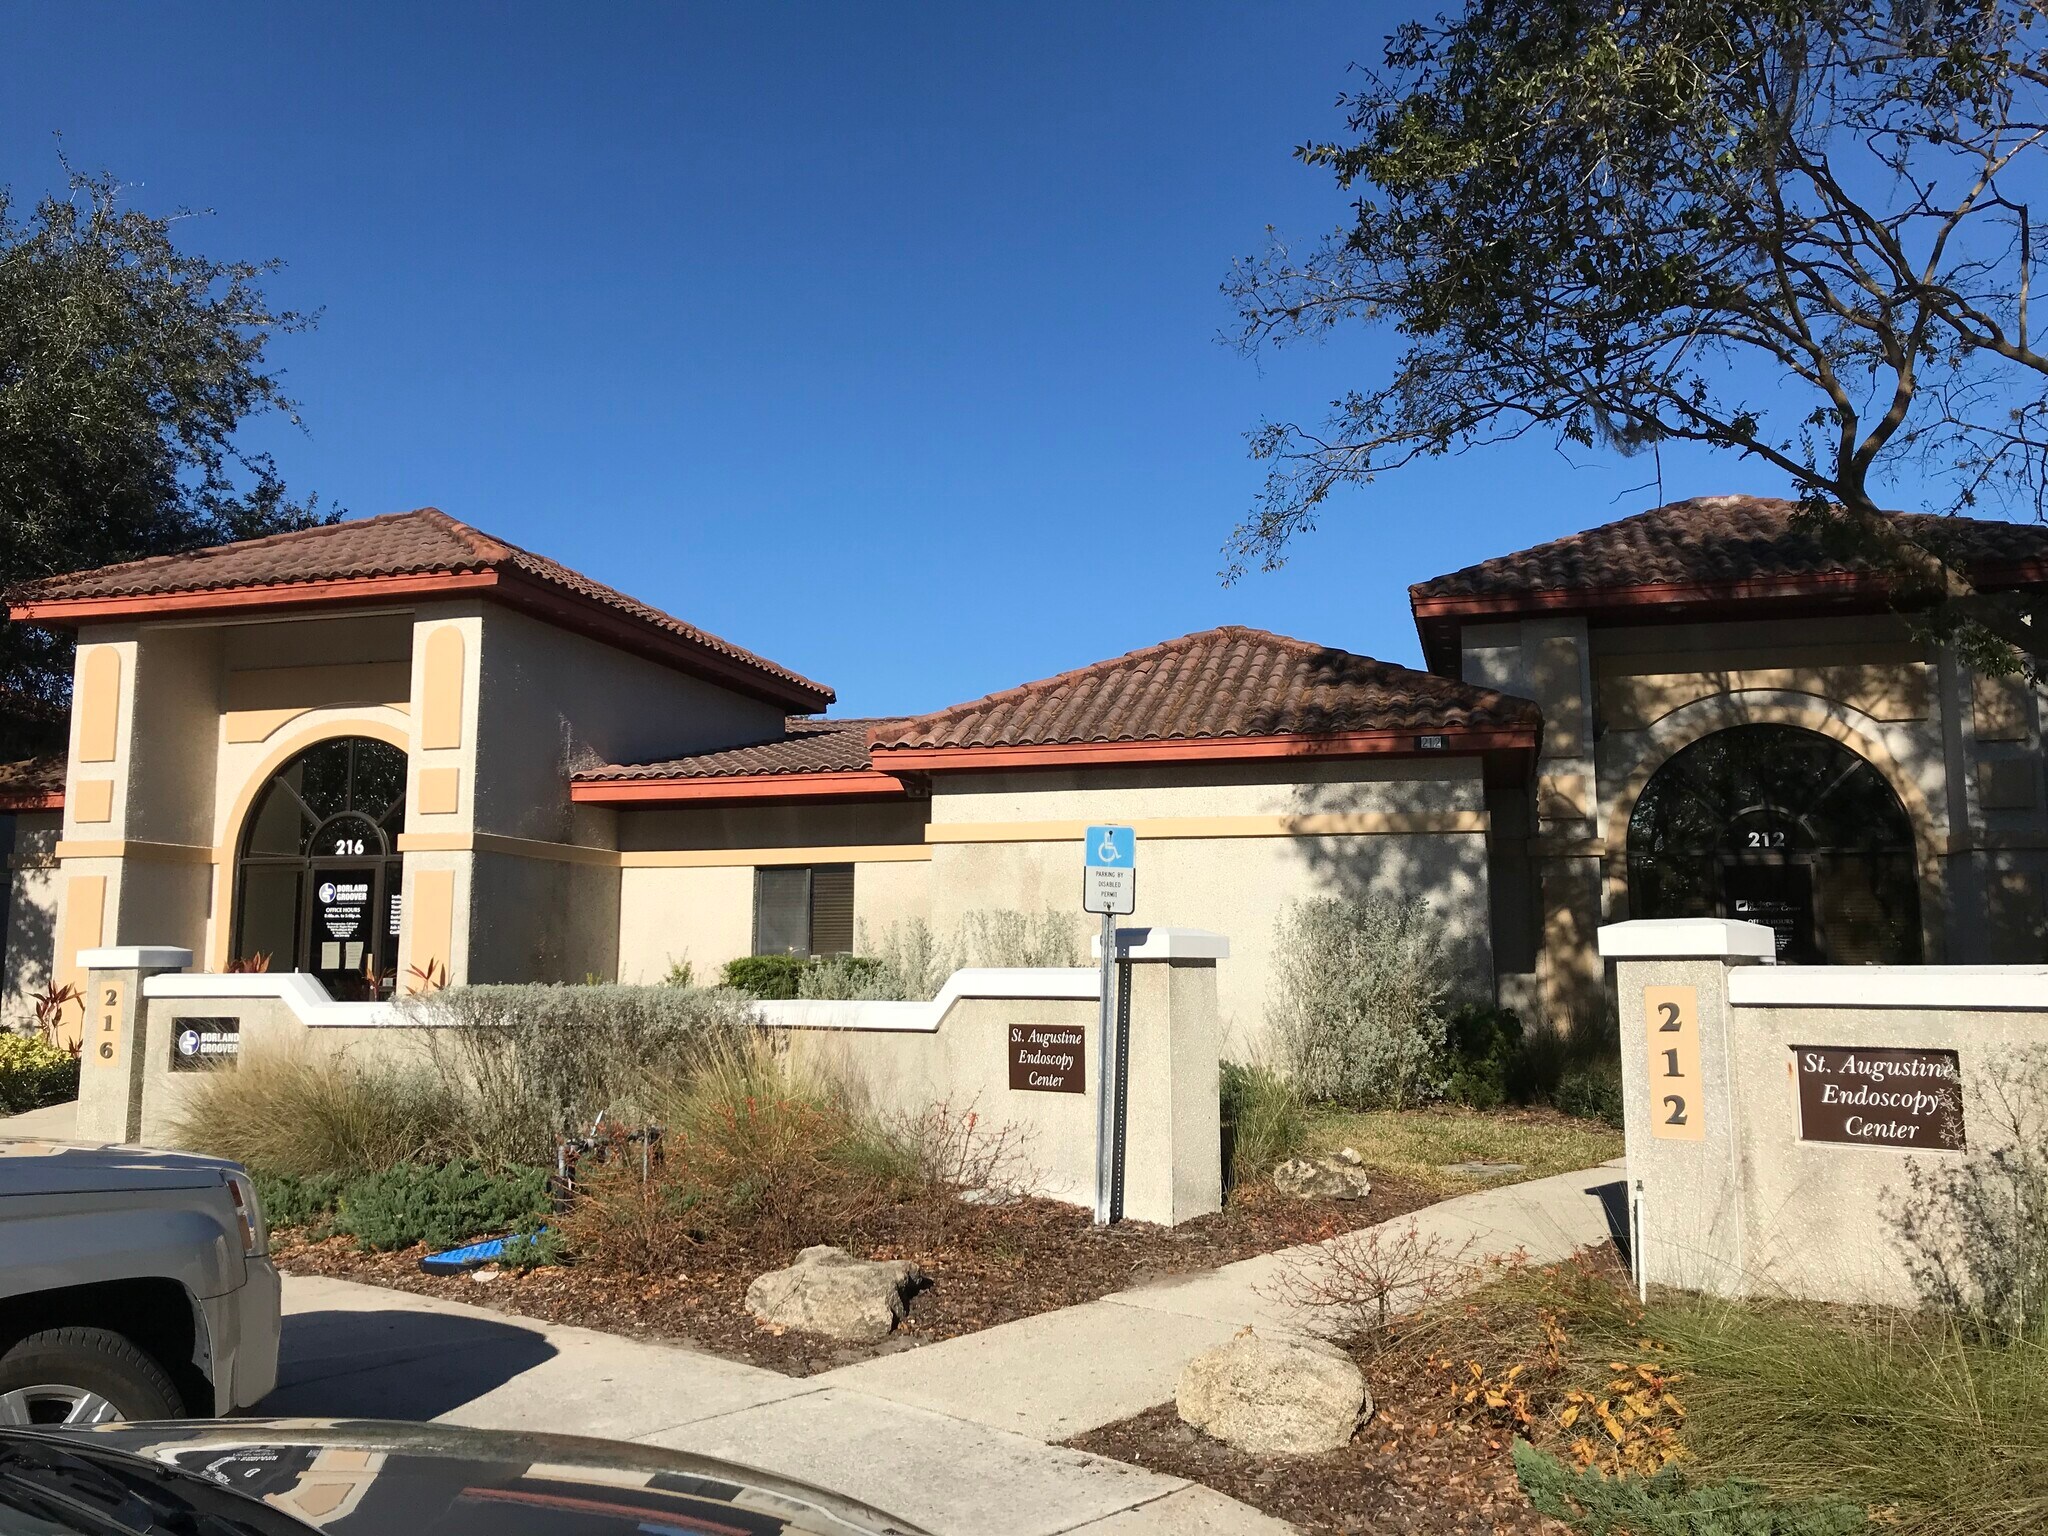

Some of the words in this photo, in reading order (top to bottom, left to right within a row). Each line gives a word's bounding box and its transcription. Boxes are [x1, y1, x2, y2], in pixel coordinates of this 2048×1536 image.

[1422, 737, 1441, 748] 212
[335, 839, 364, 855] 216
[1748, 831, 1785, 848] 212
[1095, 870, 1115, 878] PARKING
[336, 884, 368, 893] BORLAND
[1098, 880, 1121, 888] DISABLED
[336, 893, 367, 901] GROOVER
[99, 988, 118, 1060] 216
[200, 1032, 240, 1043] BORLAND
[1011, 1027, 1025, 1043] St.
[1027, 1028, 1082, 1048] Augustine
[200, 1043, 239, 1053] GROOVER
[1018, 1049, 1074, 1071] Endoscopy
[1657, 1001, 1688, 1126] 212
[1803, 1053, 1832, 1074] St.
[1838, 1054, 1955, 1082] Augustine
[1028, 1070, 1065, 1087] Center
[1821, 1083, 1940, 1116] Endoscopy
[1844, 1116, 1920, 1140] Center
